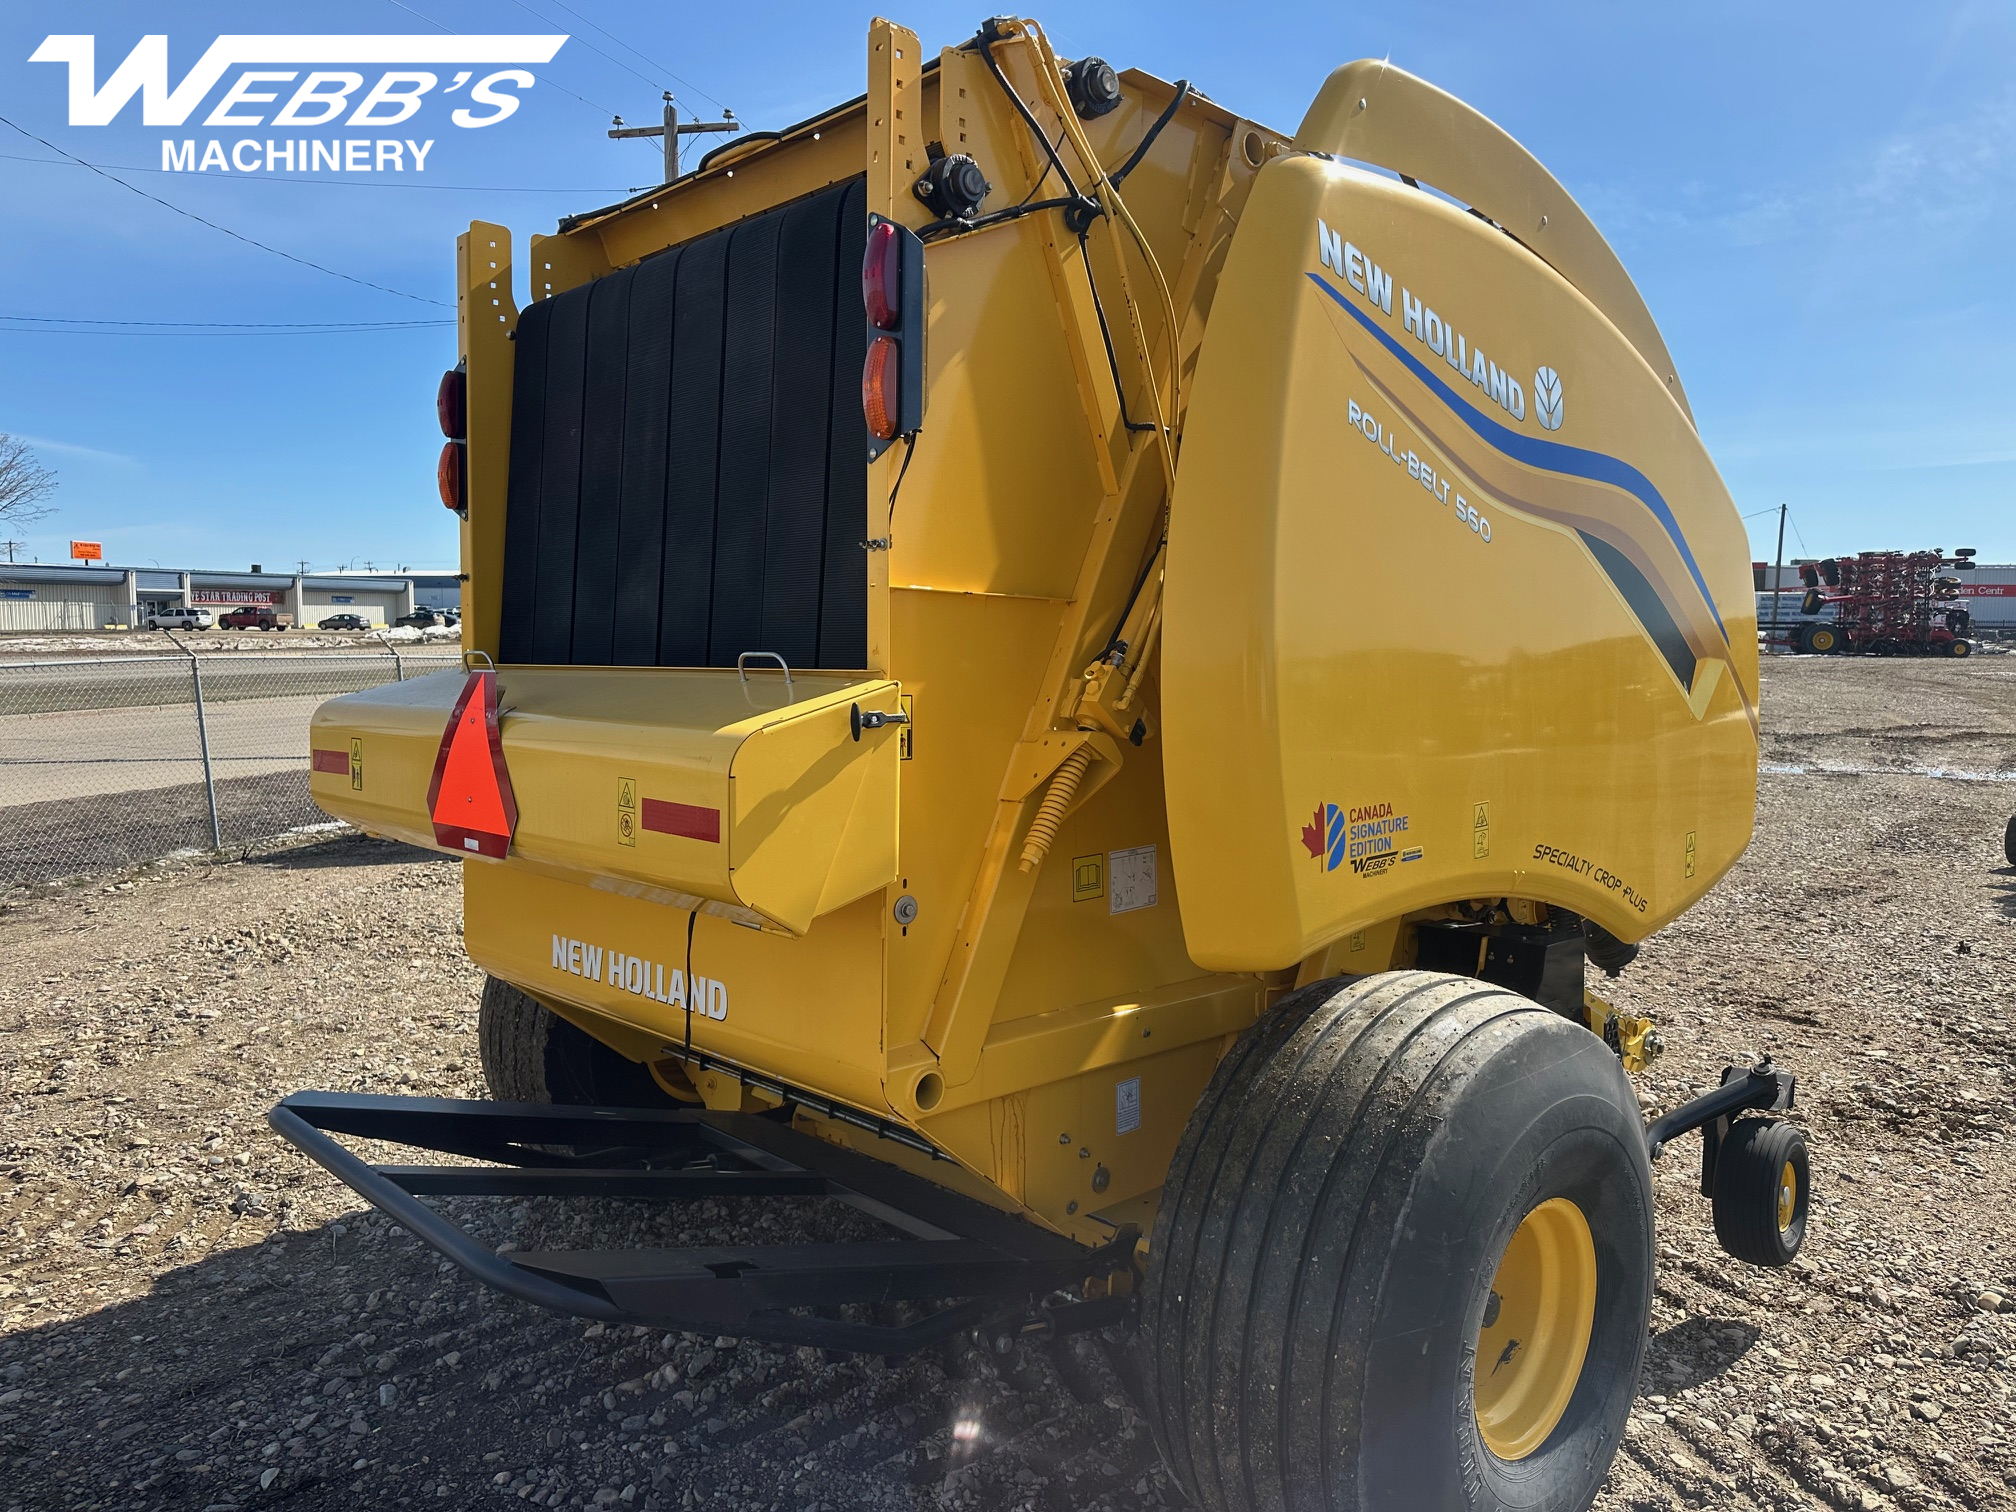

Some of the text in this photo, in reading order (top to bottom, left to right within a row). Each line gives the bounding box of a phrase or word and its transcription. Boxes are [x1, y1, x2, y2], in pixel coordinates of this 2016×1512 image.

[1318, 218, 1526, 422] NEW HOLLAND
[1348, 397, 1492, 544] ROLL-BELT 560
[201, 591, 220, 602] STAR
[221, 592, 253, 602] TRADING
[255, 593, 271, 602] POST
[1349, 802, 1393, 823] CANADA
[1350, 816, 1408, 840] SIGNATURE
[1349, 836, 1392, 859] EDITION
[1350, 850, 1399, 874] WEBB'S
[1362, 868, 1388, 879] MACHINERY
[1533, 844, 1594, 876] SPECIALTY
[1594, 868, 1622, 891] CROP
[552, 935, 728, 1021] NEW HOLLAND
